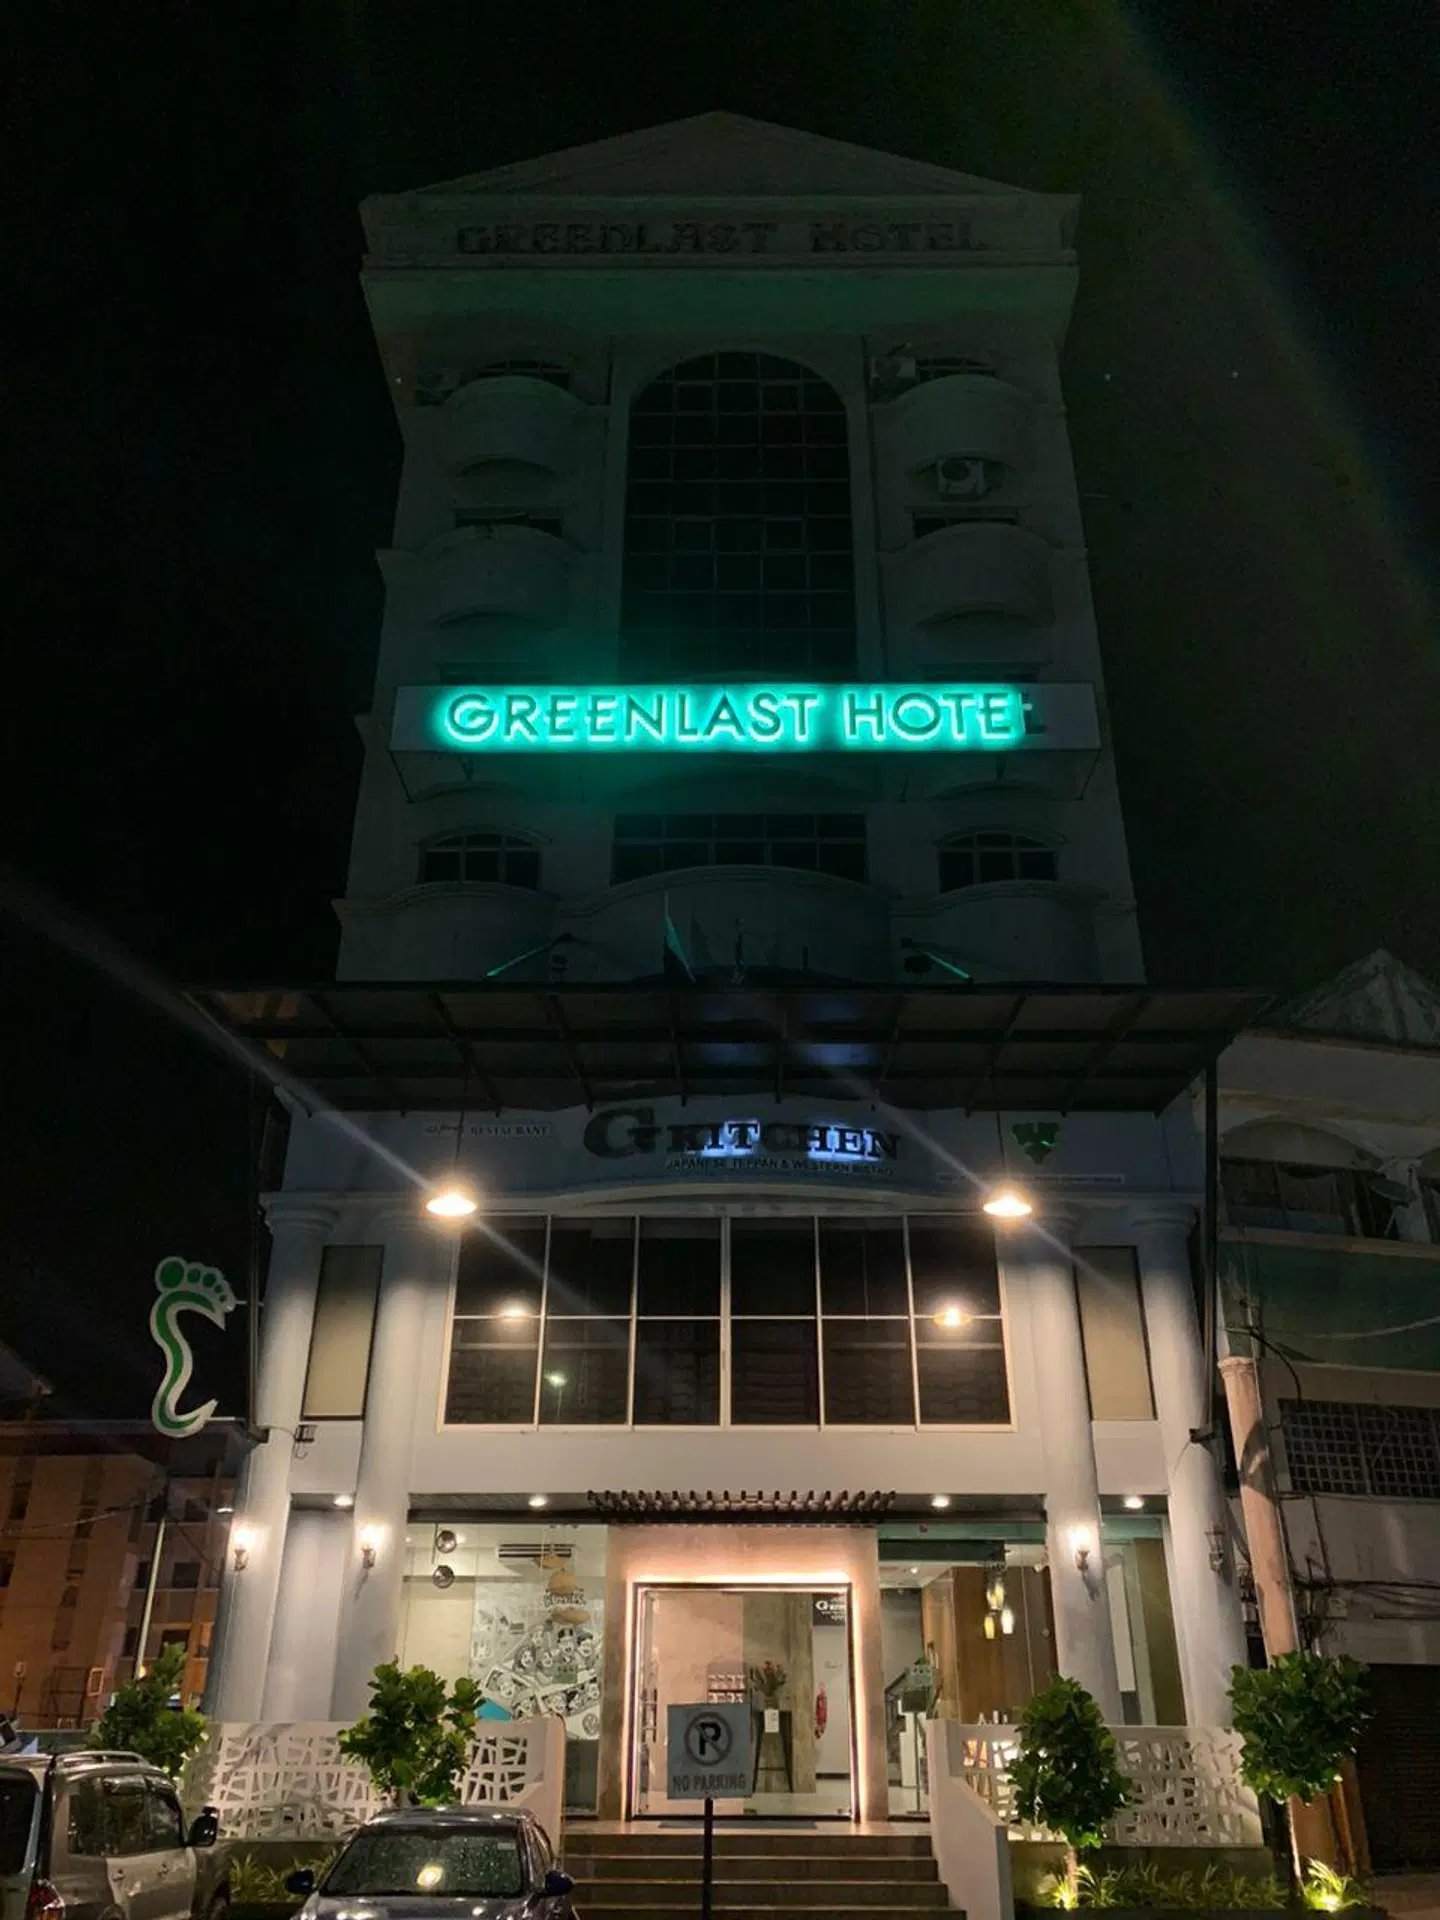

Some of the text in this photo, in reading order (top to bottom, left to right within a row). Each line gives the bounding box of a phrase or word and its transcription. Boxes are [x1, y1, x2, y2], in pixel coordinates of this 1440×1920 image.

[456, 221, 989, 254] GREENLAST HOTEL
[446, 691, 1048, 743] GREENLAST HOTEL
[673, 1773, 747, 1792] NO PARKING
